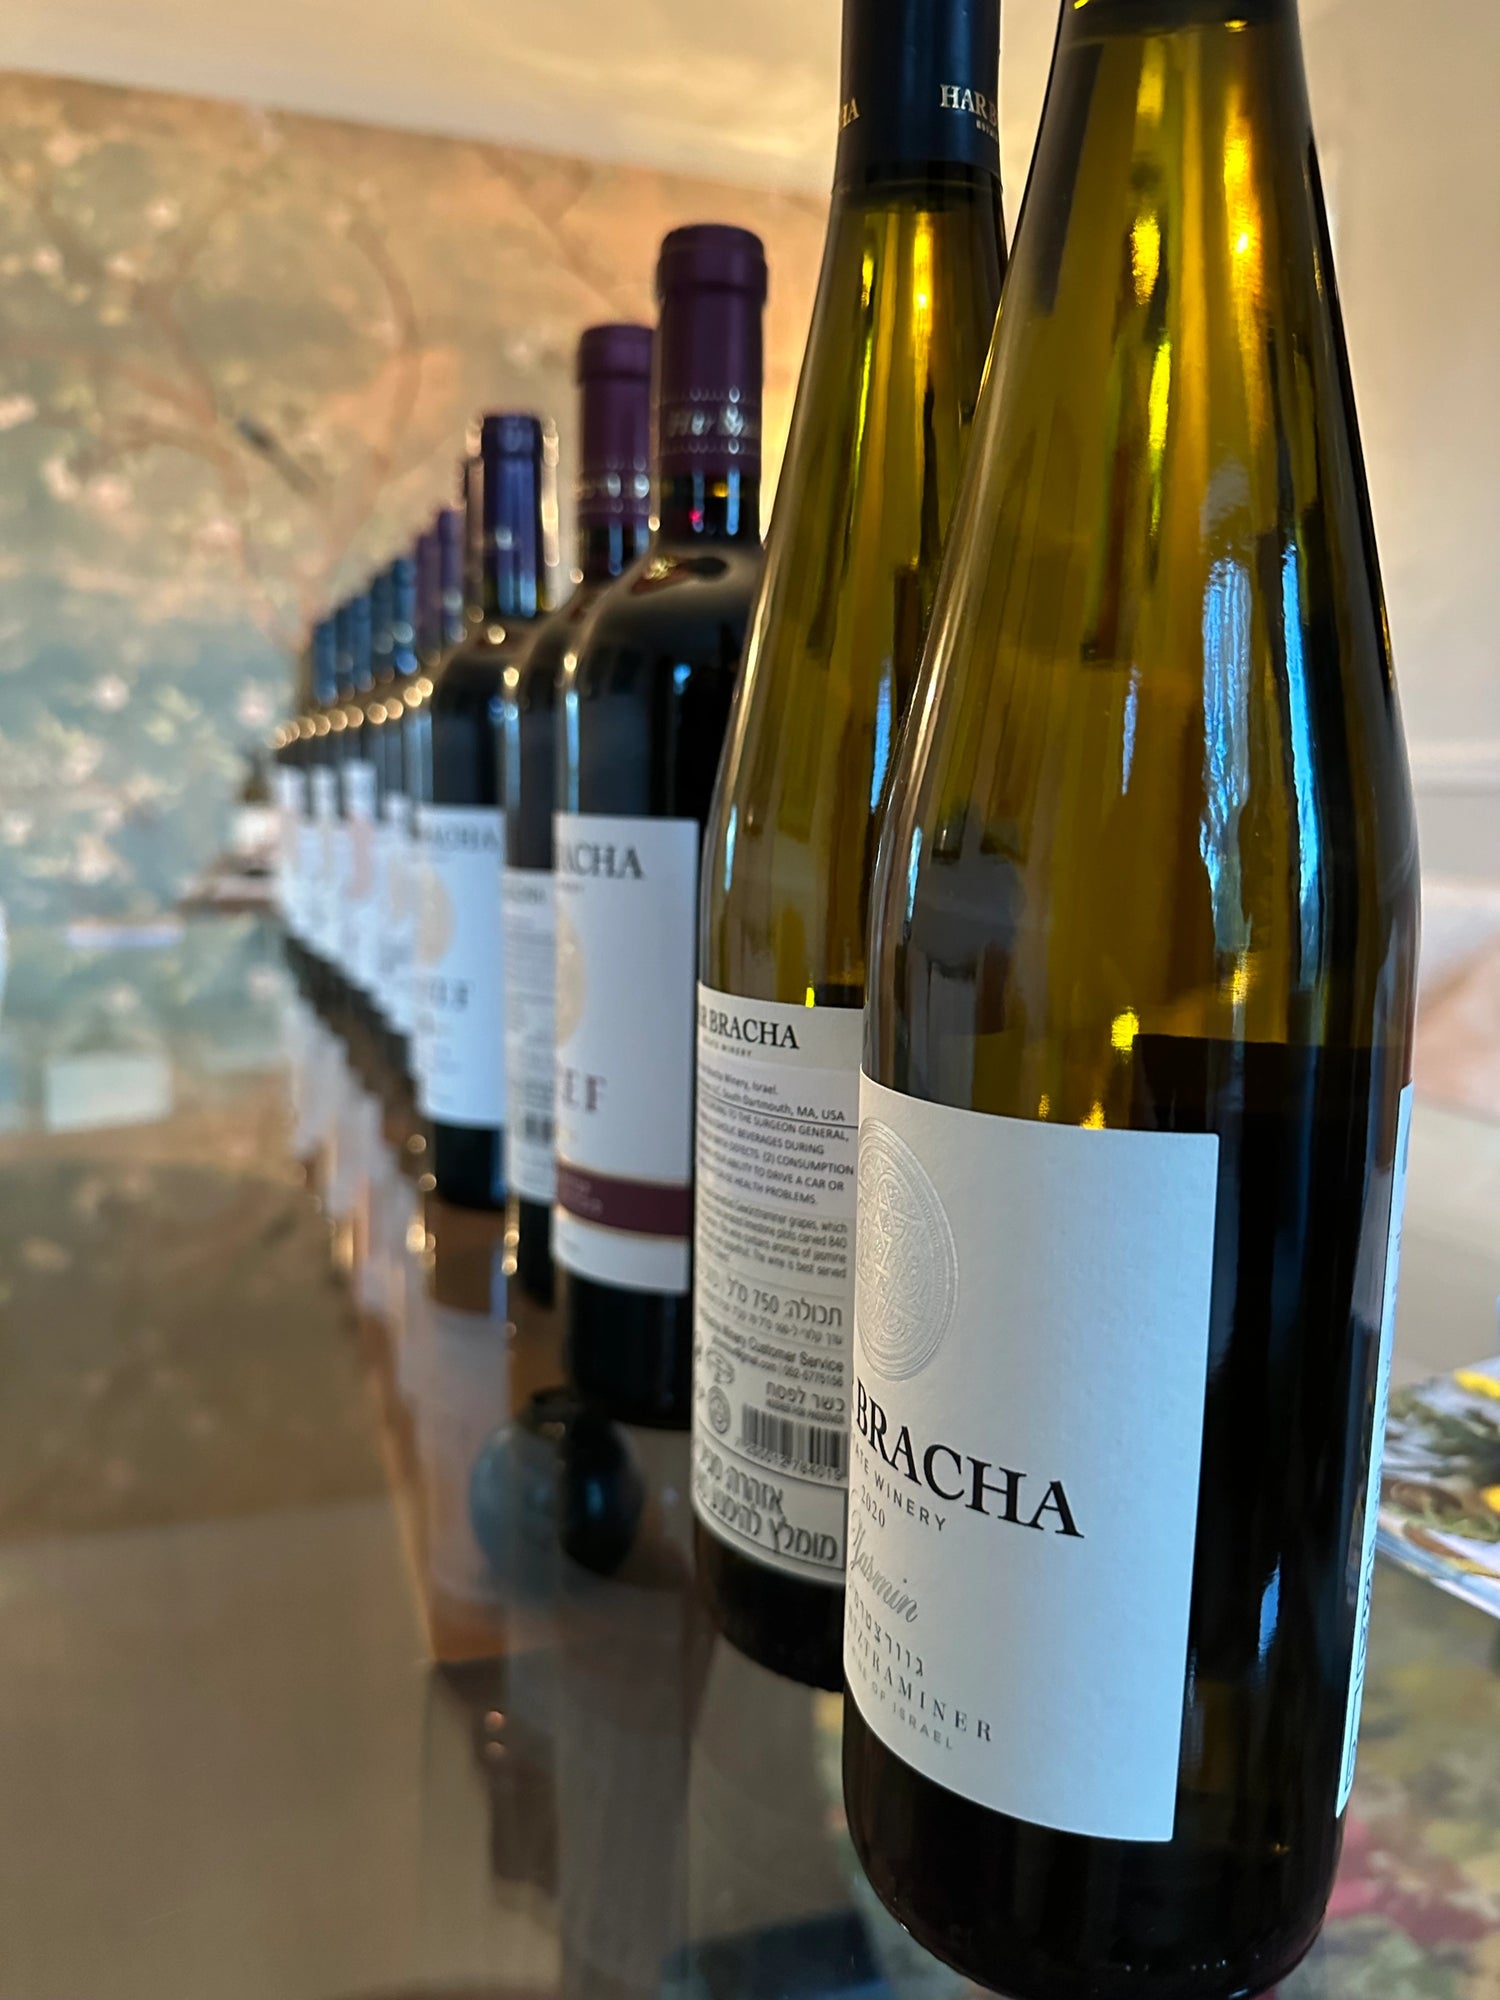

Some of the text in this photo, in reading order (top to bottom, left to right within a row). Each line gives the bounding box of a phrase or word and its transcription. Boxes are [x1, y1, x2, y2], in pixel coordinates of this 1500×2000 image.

[562, 842, 645, 880] ACHA
[709, 1010, 800, 1050] BRACHA
[743, 1095, 794, 1116] Dartmouth,
[797, 1106, 818, 1119] MA,
[821, 1109, 845, 1121] USA
[737, 1129, 824, 1155] BEVERAGES DURING
[753, 1117, 796, 1133] SURGEON
[798, 1125, 849, 1141] GENERAL,
[754, 1165, 765, 1177] TO
[766, 1168, 793, 1183] DRIVE
[804, 1177, 826, 1189] CAR
[828, 1180, 845, 1191] OR
[762, 1151, 775, 1164] (2)
[776, 1155, 854, 1175] CONSUMPTION
[764, 1185, 818, 1205] PROBLEMS.
[821, 1221, 849, 1234] which
[753, 1289, 780, 1315] 750
[748, 1336, 797, 1363] Customer
[800, 1350, 845, 1373] Service
[766, 1381, 846, 1412] כשר לפסח
[856, 1377, 1085, 1538] BRACHA
[861, 1484, 885, 1528] 2020
[874, 1469, 947, 1531] WINERY
[769, 1514, 838, 1561] מומלץ
[849, 1508, 919, 1623] Jasmin
[871, 1681, 886, 1702] OF
[893, 1701, 953, 1751] ISRAEL
